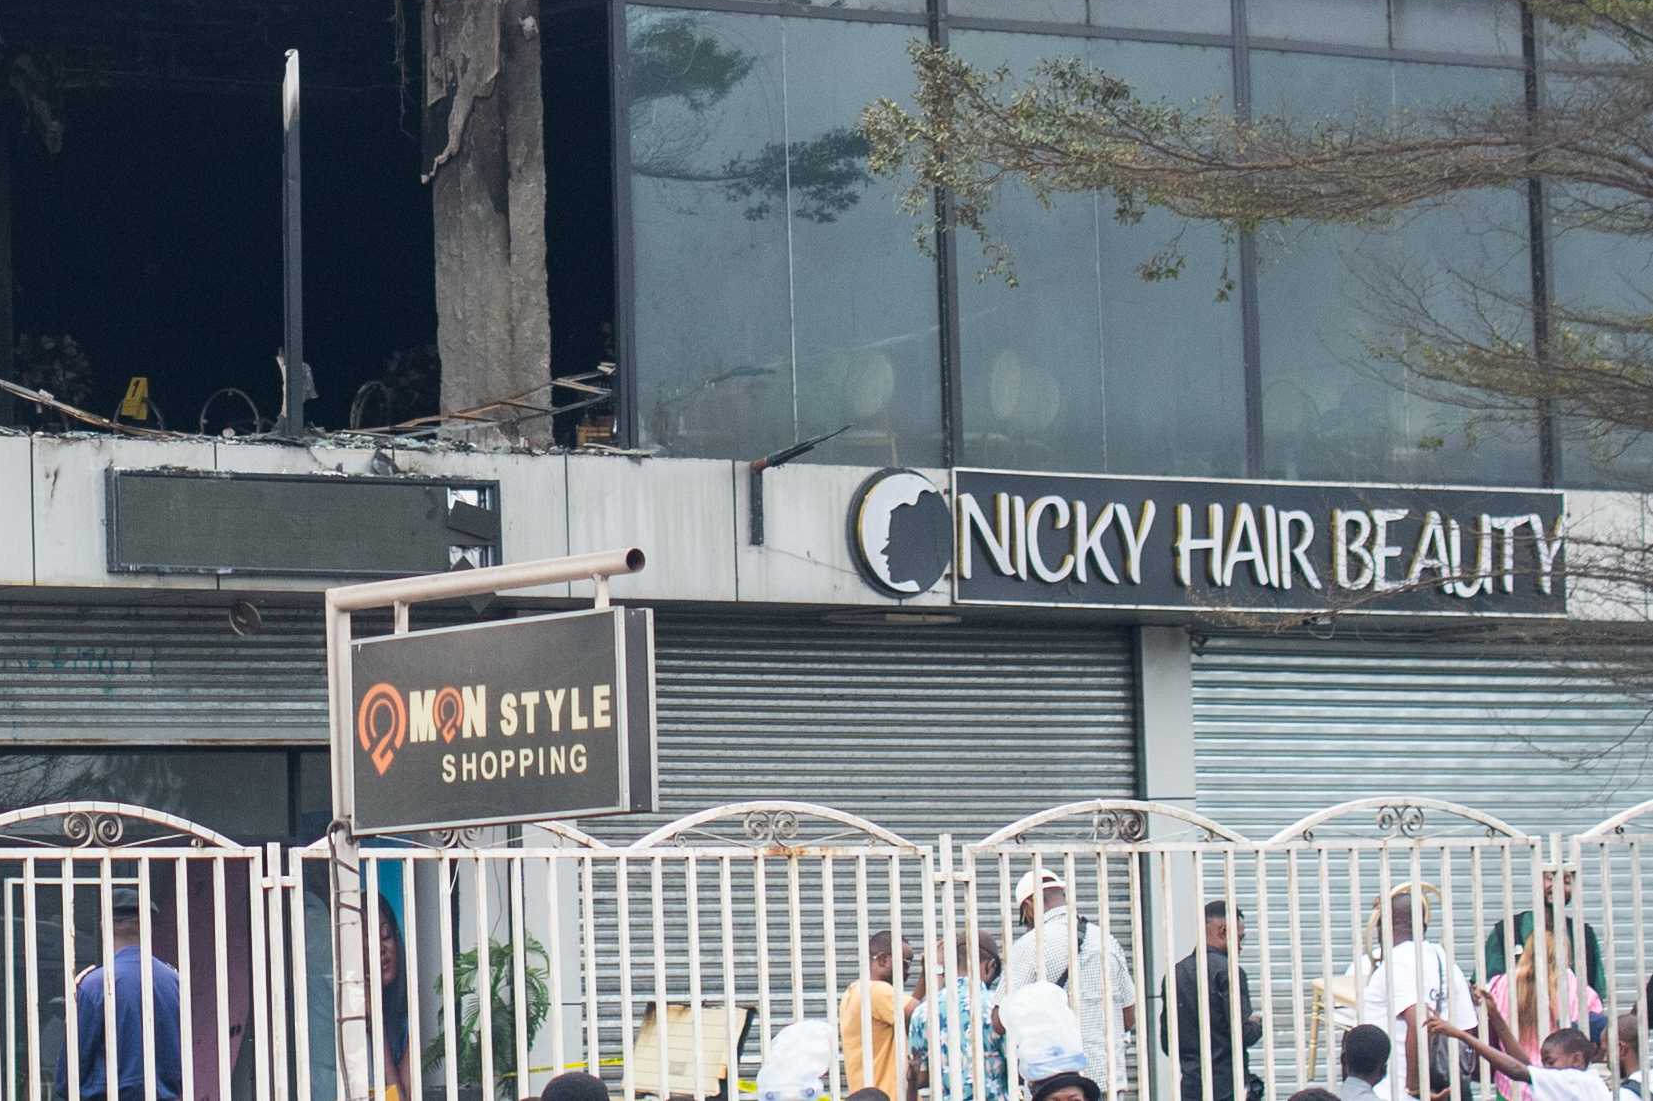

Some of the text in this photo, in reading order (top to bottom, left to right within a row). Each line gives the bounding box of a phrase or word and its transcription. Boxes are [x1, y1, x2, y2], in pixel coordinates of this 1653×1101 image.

[958, 492, 1564, 598] NICKY HAIR BEAUTY
[500, 684, 611, 736] STYLE
[442, 744, 588, 784] SHOPPING
